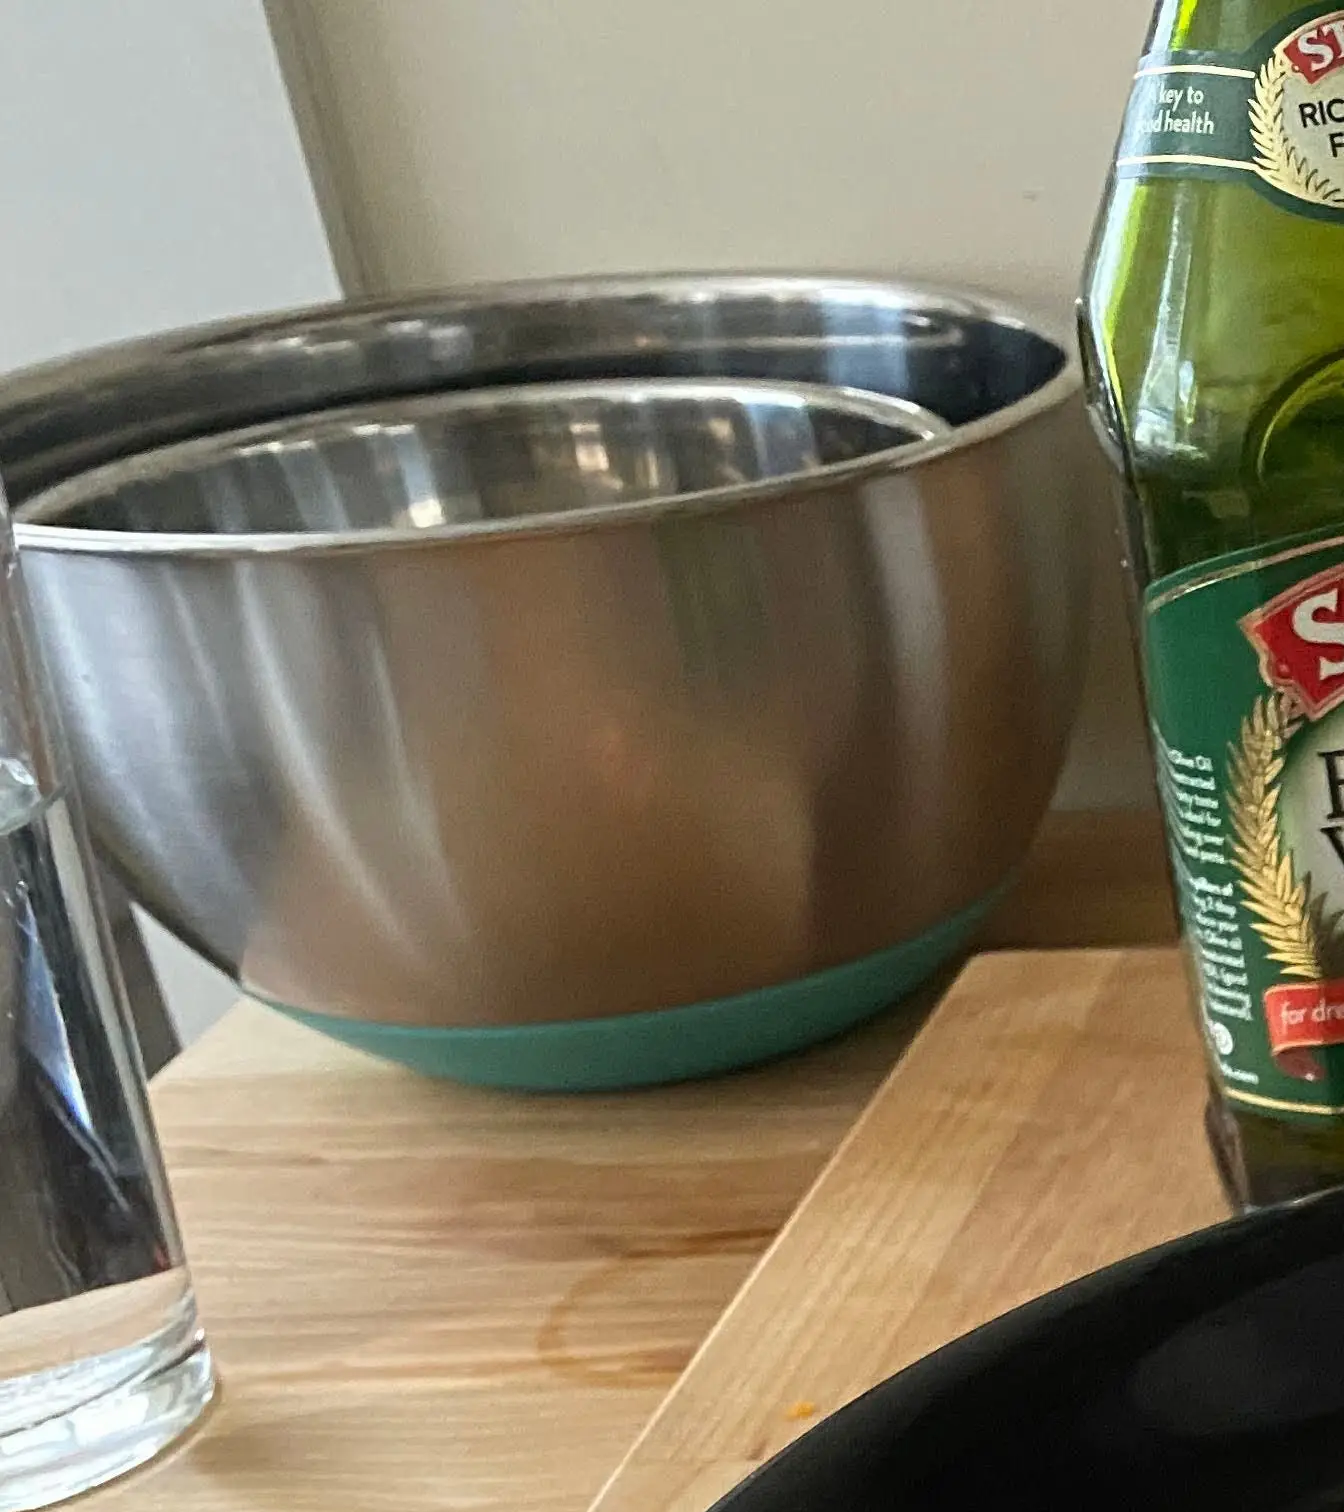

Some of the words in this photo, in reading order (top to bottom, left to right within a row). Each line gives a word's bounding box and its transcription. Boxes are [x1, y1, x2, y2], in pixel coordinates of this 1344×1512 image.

[1186, 86, 1204, 105] to
[1164, 110, 1215, 134] health
[1279, 1001, 1307, 1036] for
